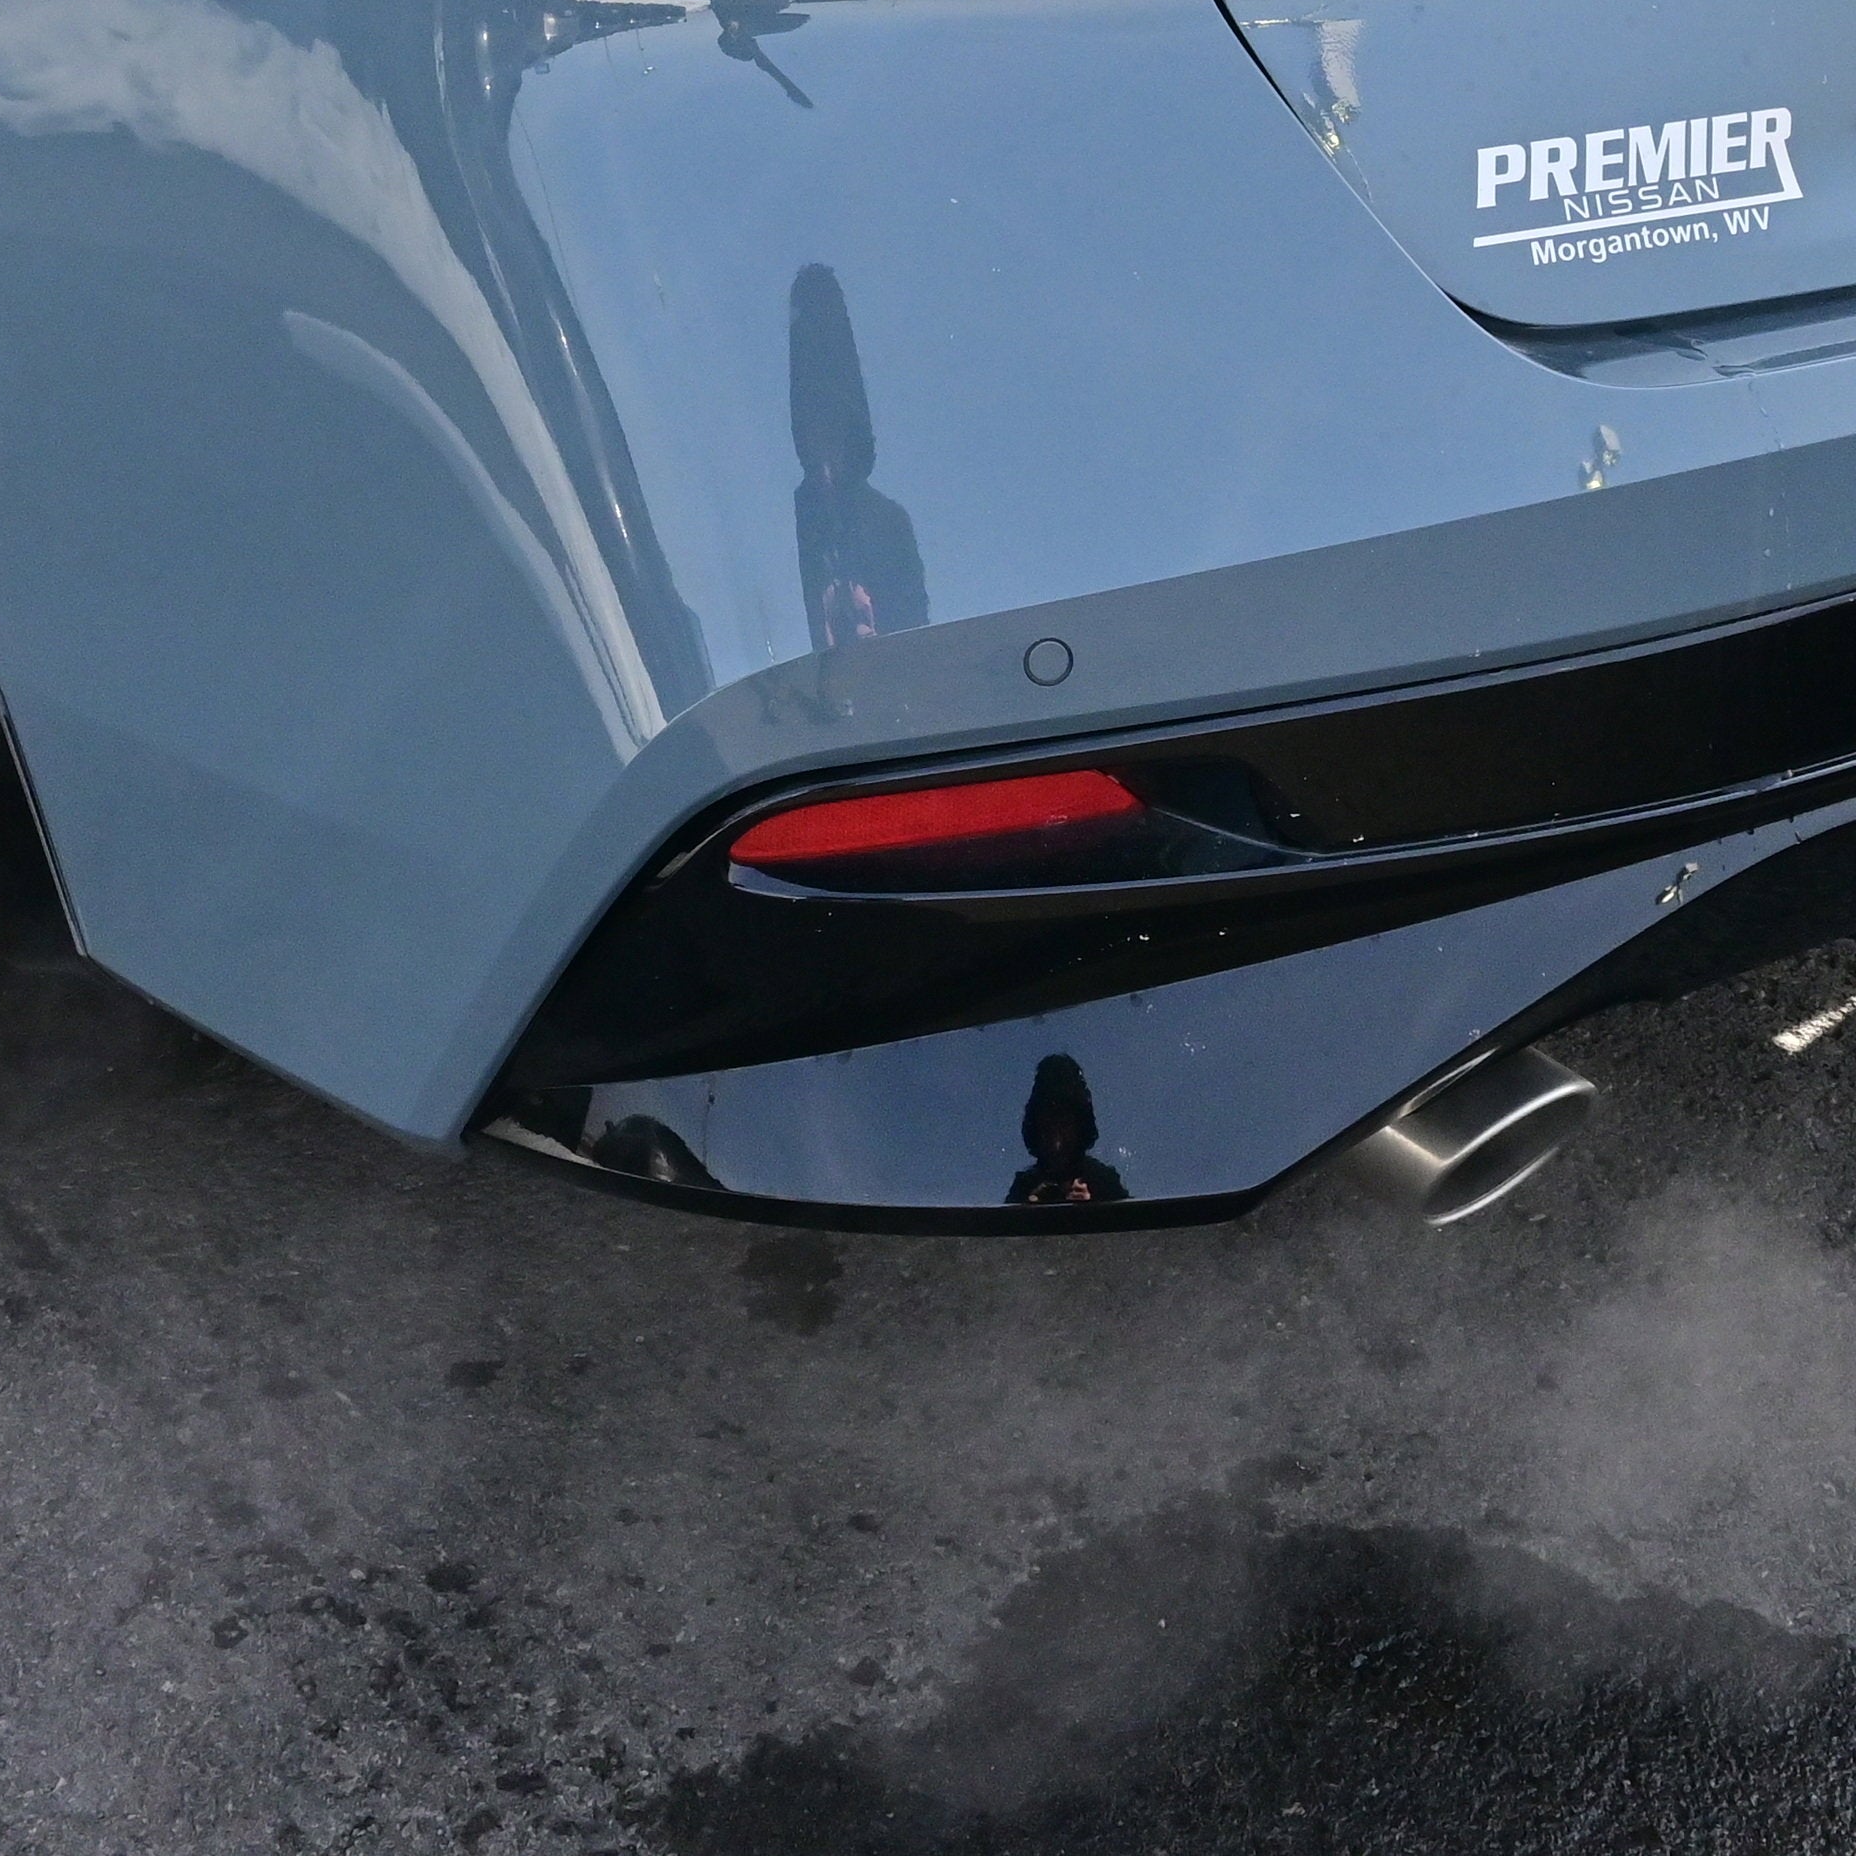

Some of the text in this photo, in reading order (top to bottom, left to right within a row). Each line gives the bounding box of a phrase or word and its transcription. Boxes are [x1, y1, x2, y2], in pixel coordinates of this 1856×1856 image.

[1475, 106, 1799, 209] PREMIER
[1562, 176, 1721, 222] NISSAN
[1530, 205, 1771, 266] Morgantown, WV
